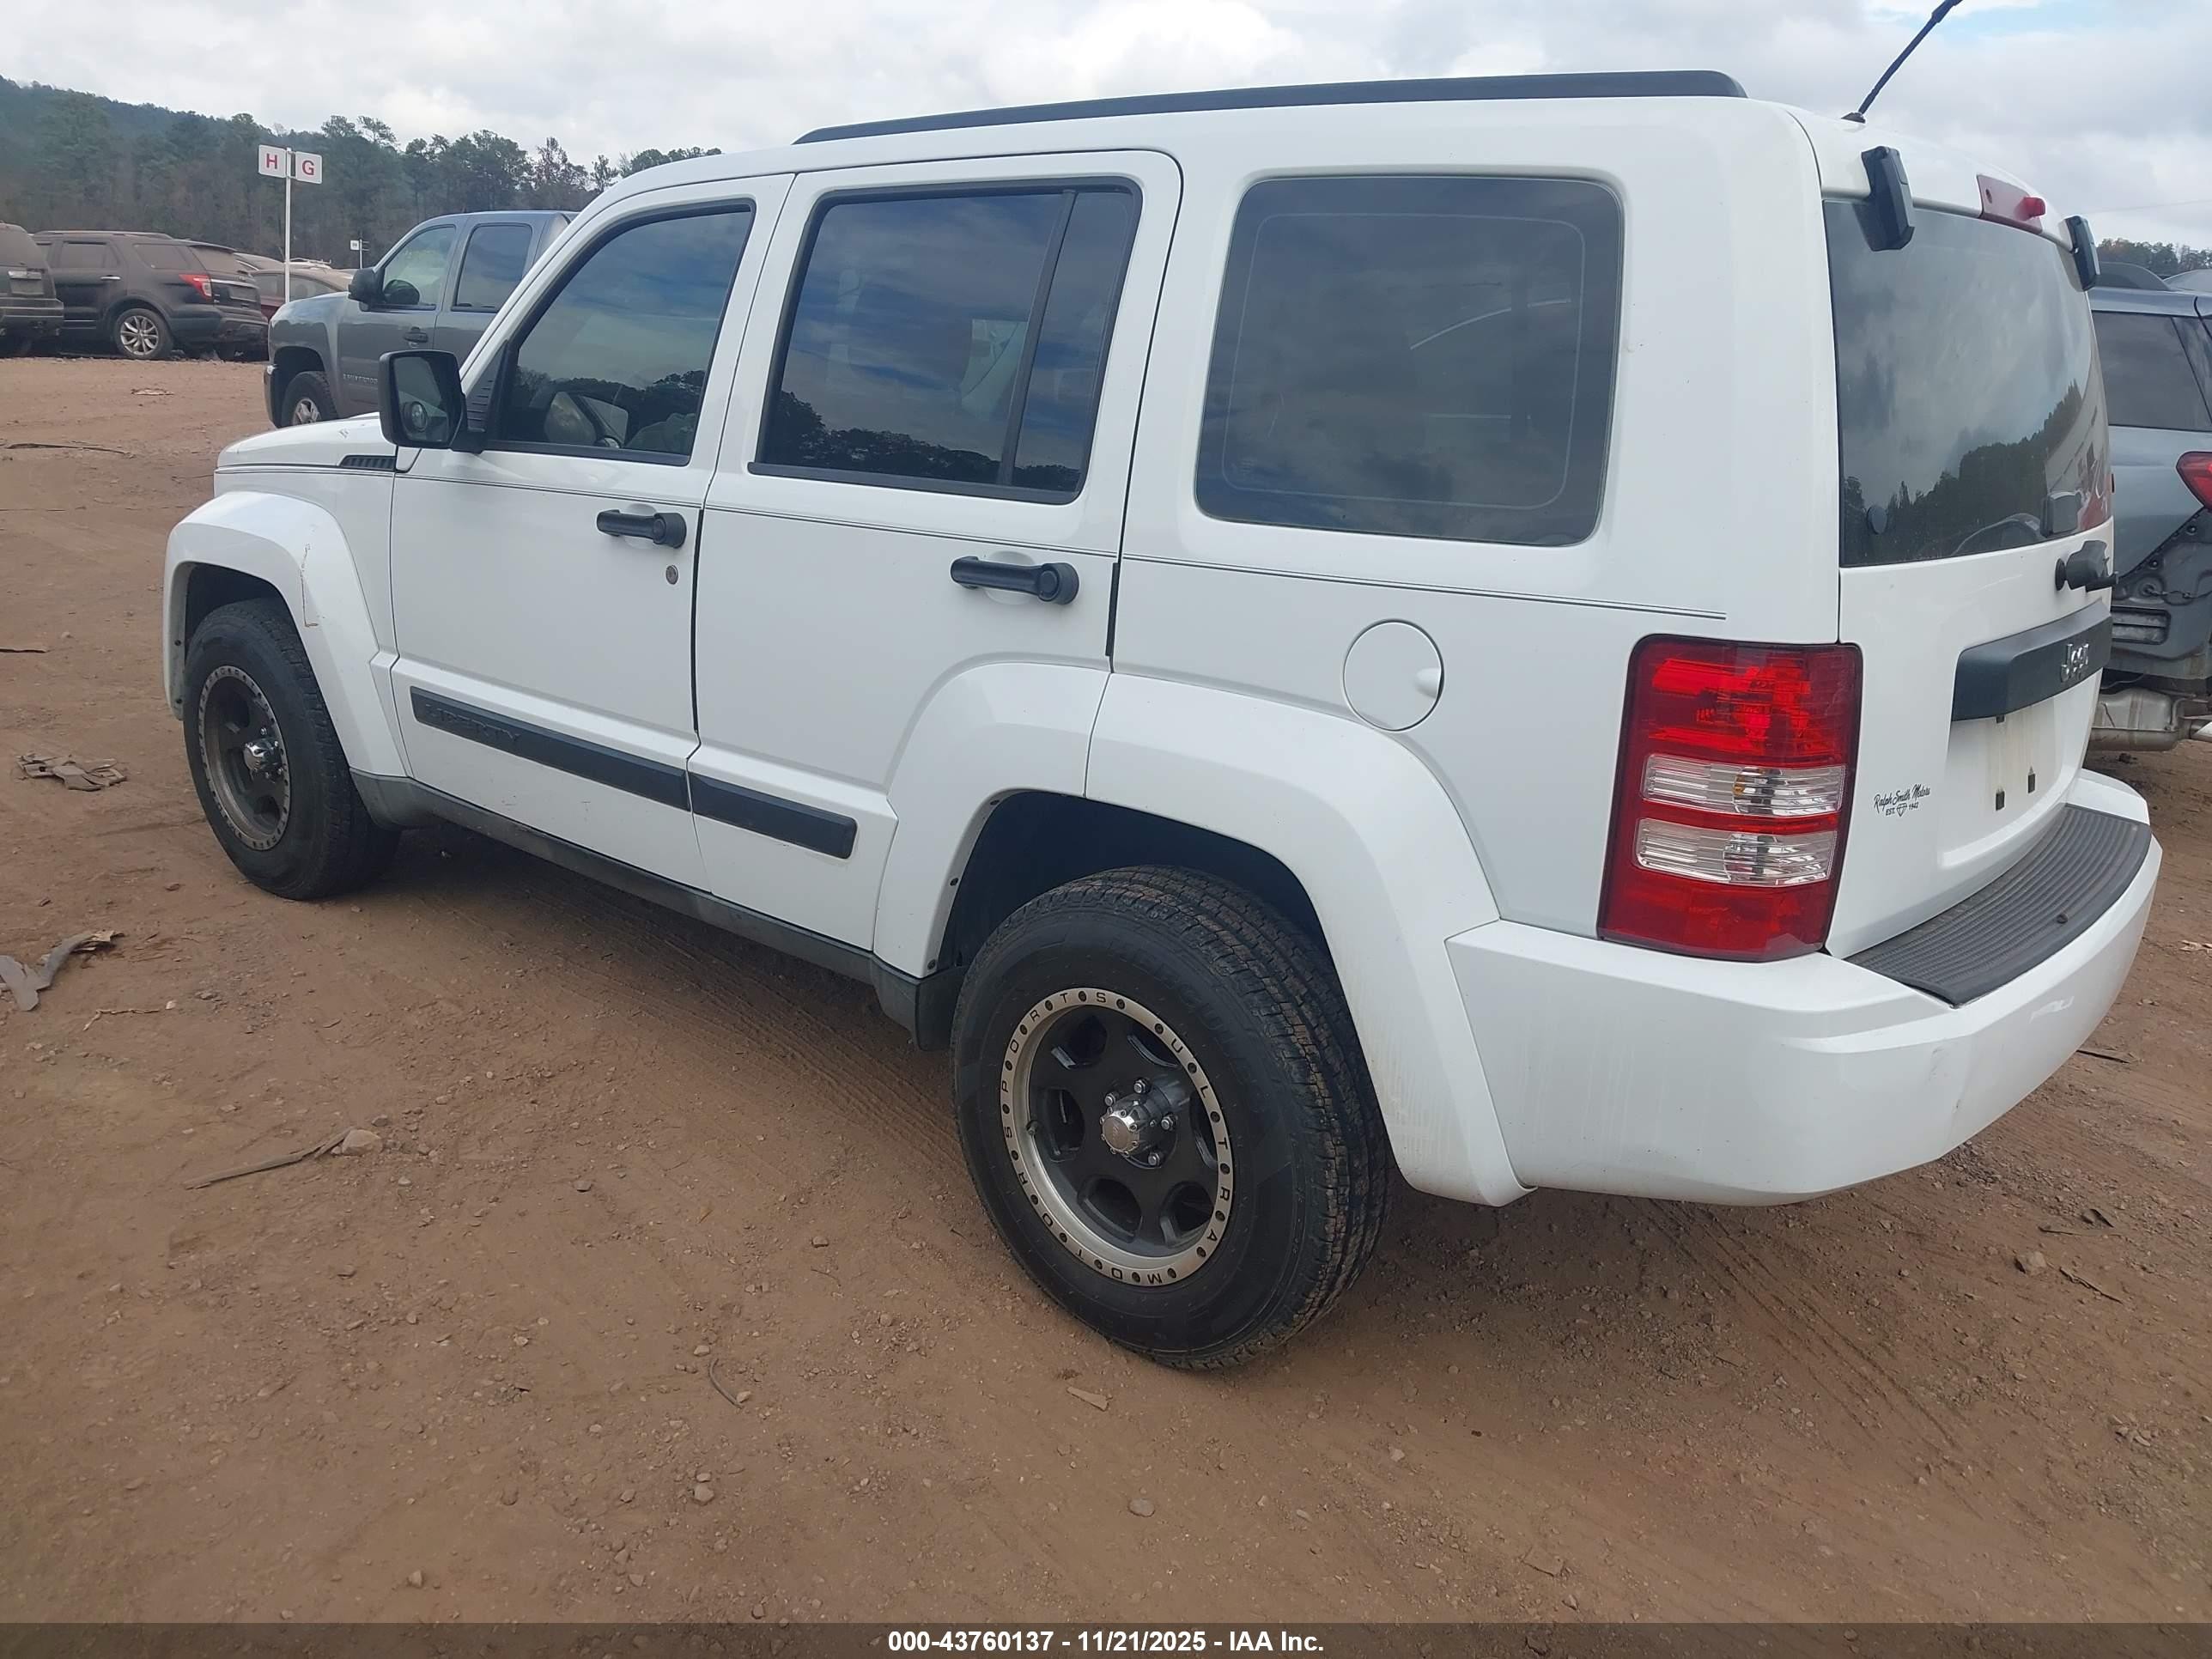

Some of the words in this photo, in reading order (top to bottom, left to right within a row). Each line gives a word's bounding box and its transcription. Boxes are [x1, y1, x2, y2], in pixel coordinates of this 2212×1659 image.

[266, 153, 277, 169] H
[302, 160, 314, 175] G
[1873, 793, 1893, 814] Ralph
[1893, 790, 1911, 805] Smith
